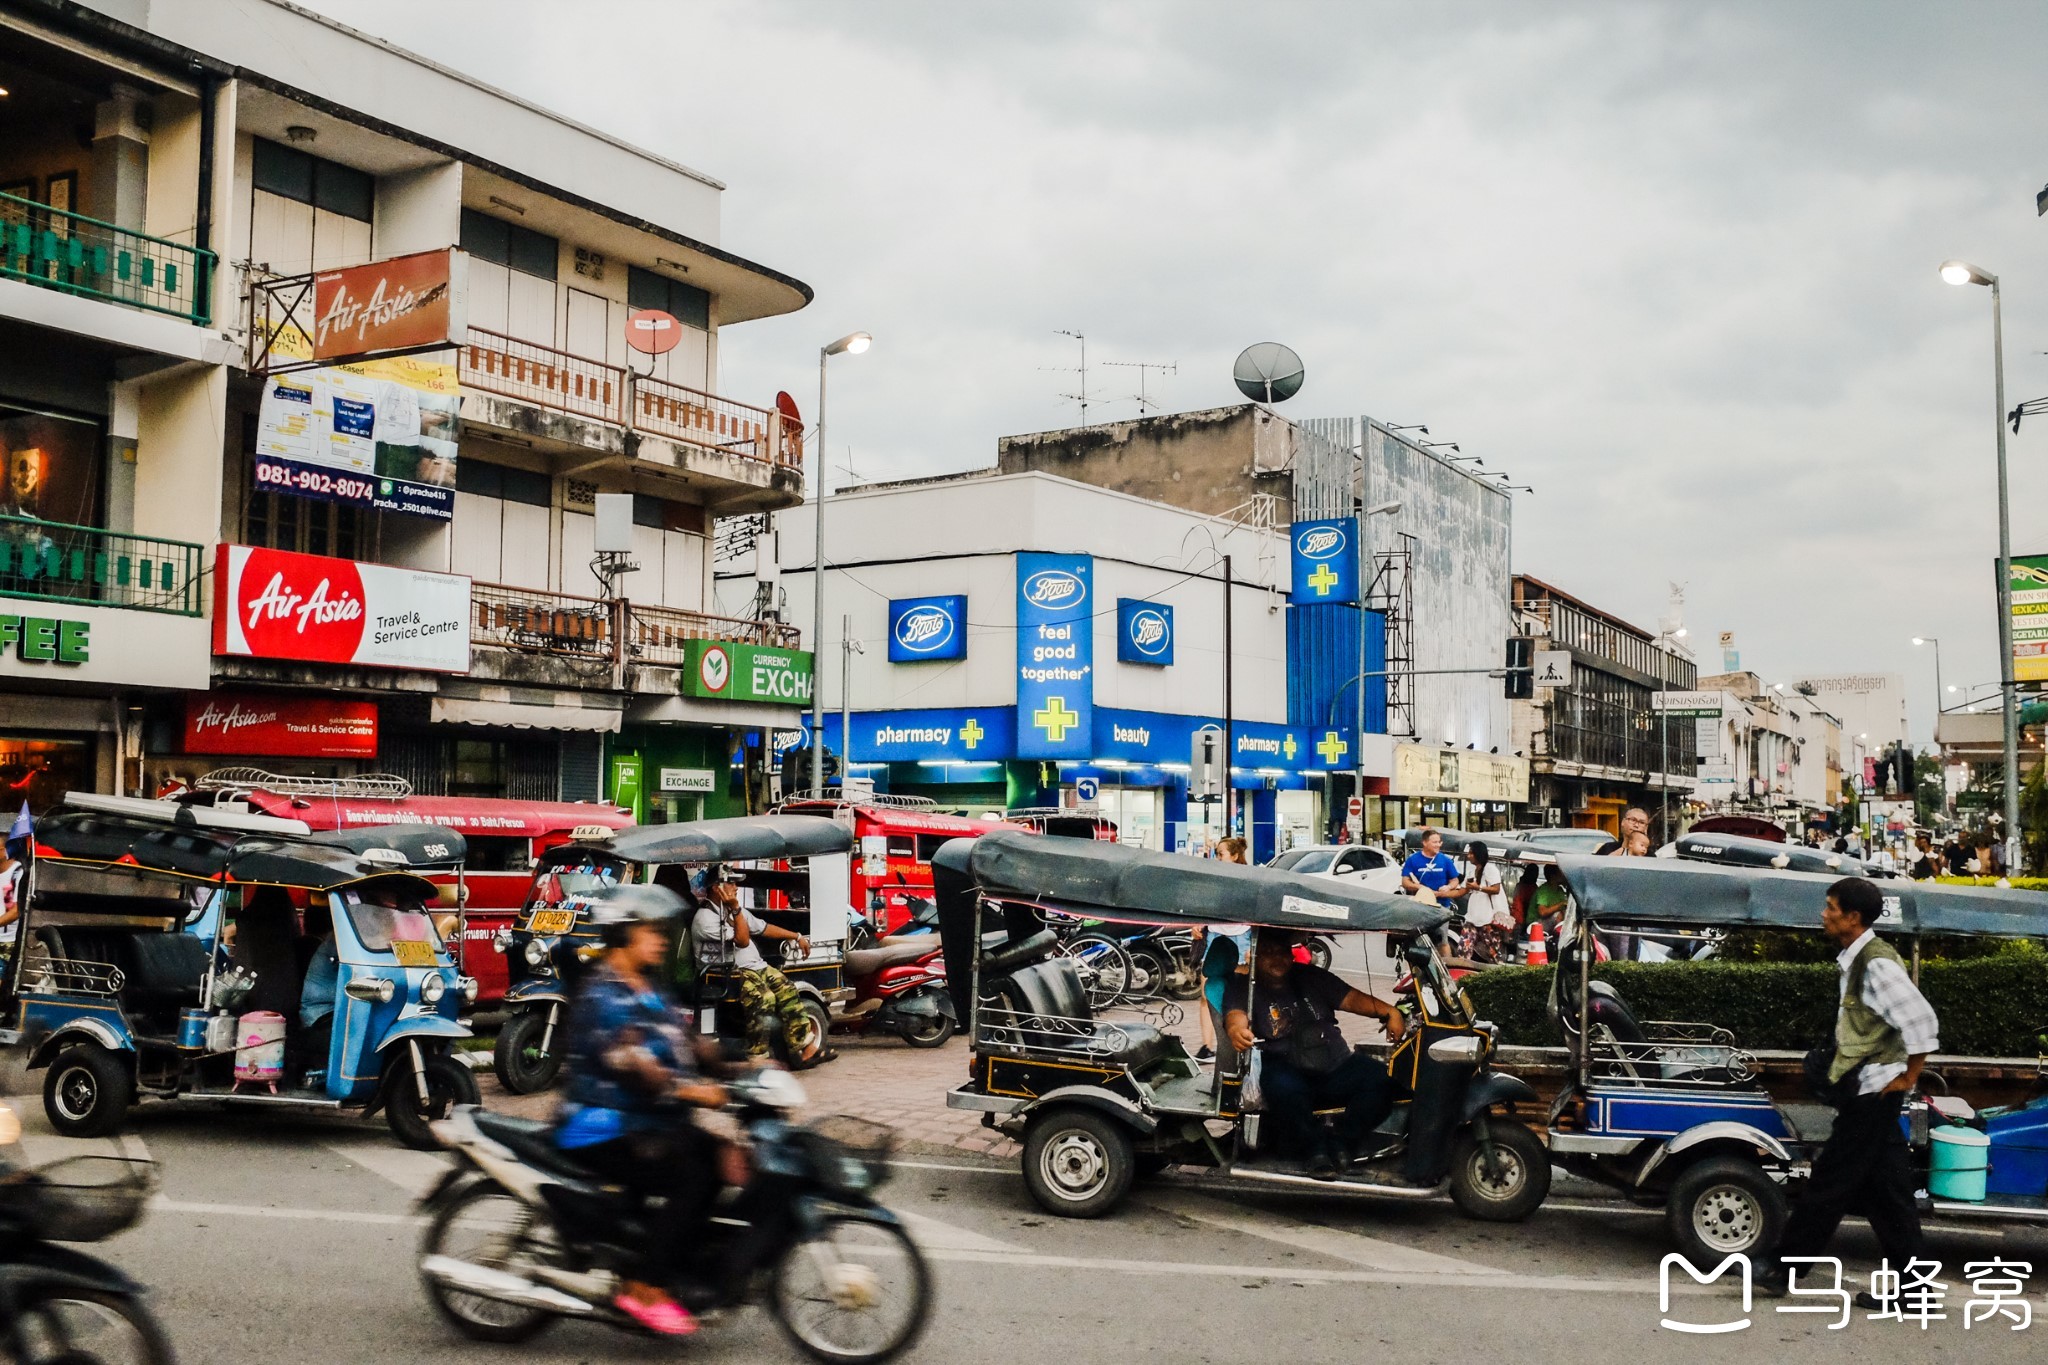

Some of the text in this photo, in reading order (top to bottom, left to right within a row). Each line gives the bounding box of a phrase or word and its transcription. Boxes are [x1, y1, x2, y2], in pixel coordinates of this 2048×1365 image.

[427, 380, 445, 391] 166
[257, 464, 374, 500] 081-902-8074
[403, 485, 447, 500] @pracha416
[373, 499, 452, 519] pracha_2501@live.com
[1031, 577, 1076, 602] Boots
[374, 621, 459, 644] Service Centre
[902, 613, 944, 643] Boots
[1038, 624, 1071, 640] feel
[1033, 643, 1076, 662] good
[752, 653, 792, 668] CURRENCY
[286, 723, 373, 735] Travel & Service Centre
[876, 726, 951, 746] pharmacy
[1113, 724, 1150, 747] beauty
[1238, 736, 1280, 753] pharmacy
[621, 767, 635, 777] ATM
[665, 777, 710, 788] EXCHANGE
[423, 815, 433, 825] 30
[469, 816, 526, 829] 30 Baht/Person
[576, 827, 602, 835] TAXI
[423, 843, 450, 858] 585
